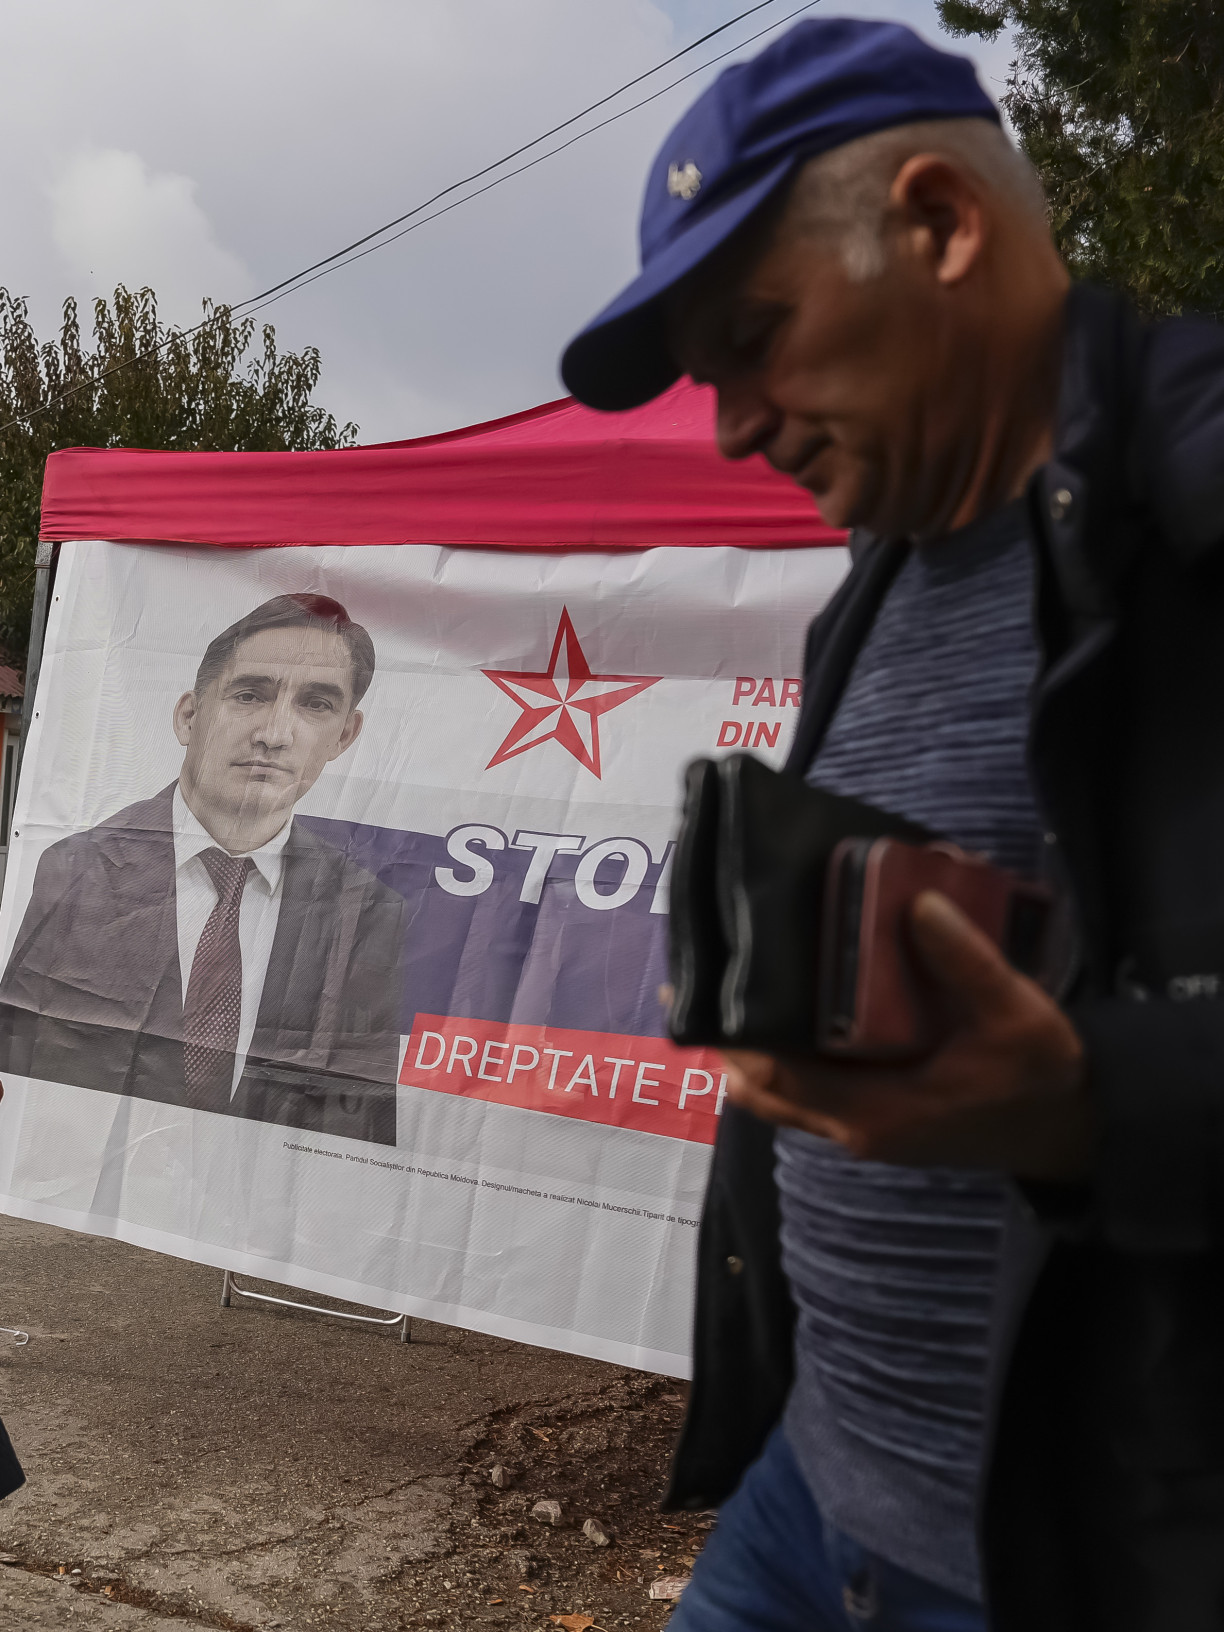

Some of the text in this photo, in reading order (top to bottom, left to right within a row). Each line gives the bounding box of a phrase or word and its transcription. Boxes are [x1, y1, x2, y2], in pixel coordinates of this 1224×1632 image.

[716, 720, 782, 748] DIN
[414, 1030, 666, 1106] DREPTATE
[282, 1141, 313, 1154] Publicitate
[345, 1153, 369, 1164] Partidul
[406, 1163, 416, 1173] din
[417, 1167, 449, 1180] Republica
[450, 1173, 480, 1186] Moldova.
[481, 1179, 542, 1198] Designul/macheta
[549, 1193, 576, 1204] realizat
[576, 1197, 601, 1209] Nicolai
[666, 1214, 676, 1223] de
